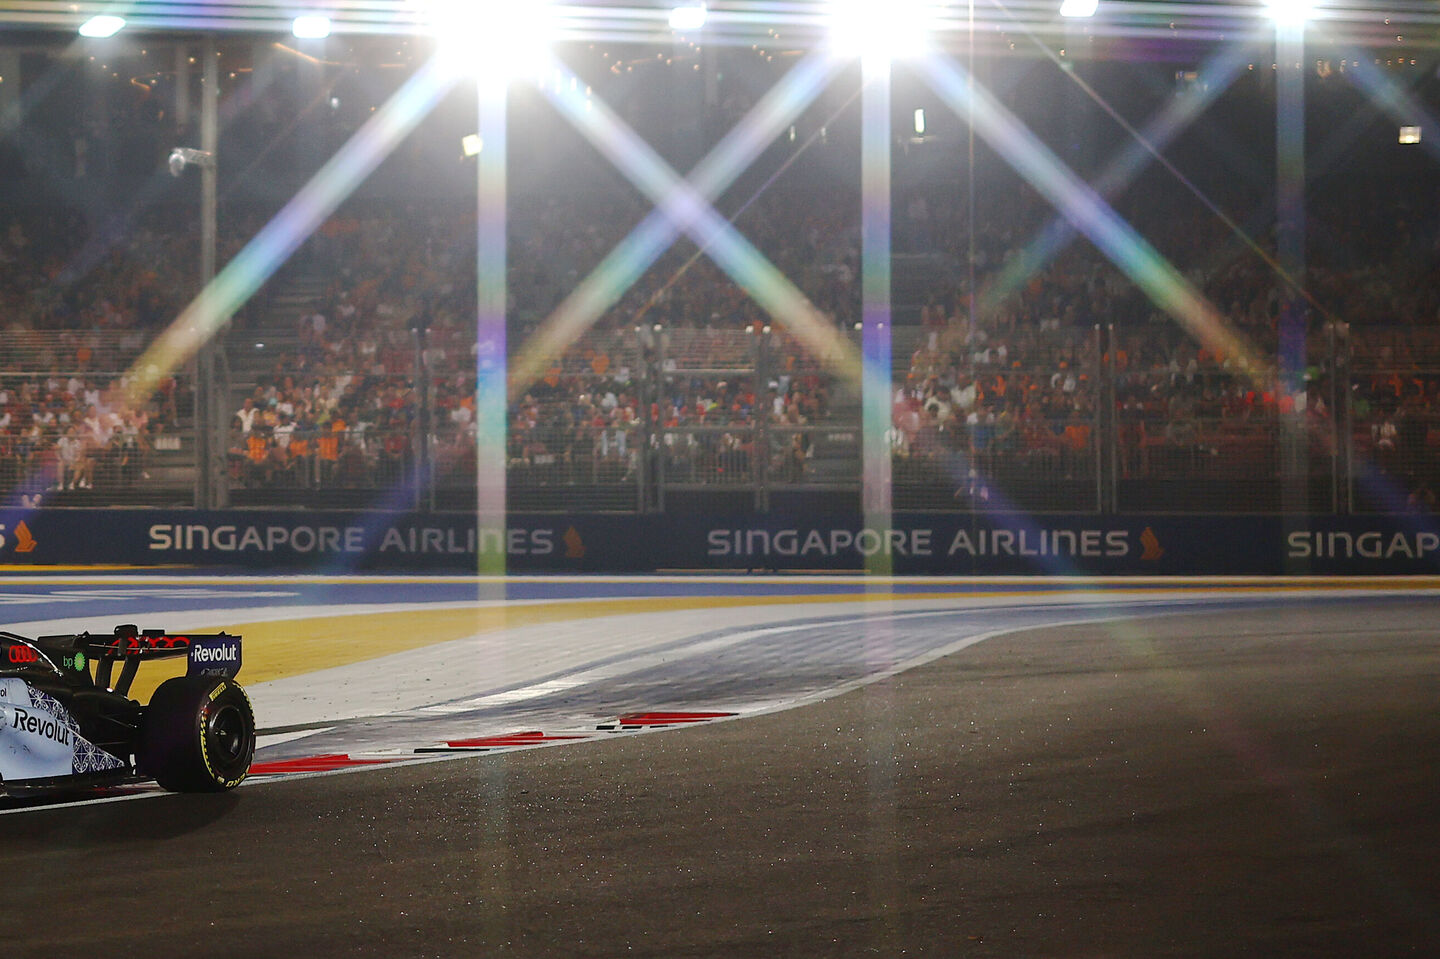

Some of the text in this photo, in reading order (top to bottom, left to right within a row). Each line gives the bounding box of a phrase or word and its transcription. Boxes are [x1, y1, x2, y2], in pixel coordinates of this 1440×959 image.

[148, 525, 554, 555] SINGAPORE AIRLINES
[707, 529, 1130, 557] SINGAPORE AIRLINES
[63, 656, 73, 668] bp
[194, 644, 237, 663] Revolut
[13, 707, 70, 746] Revolut
